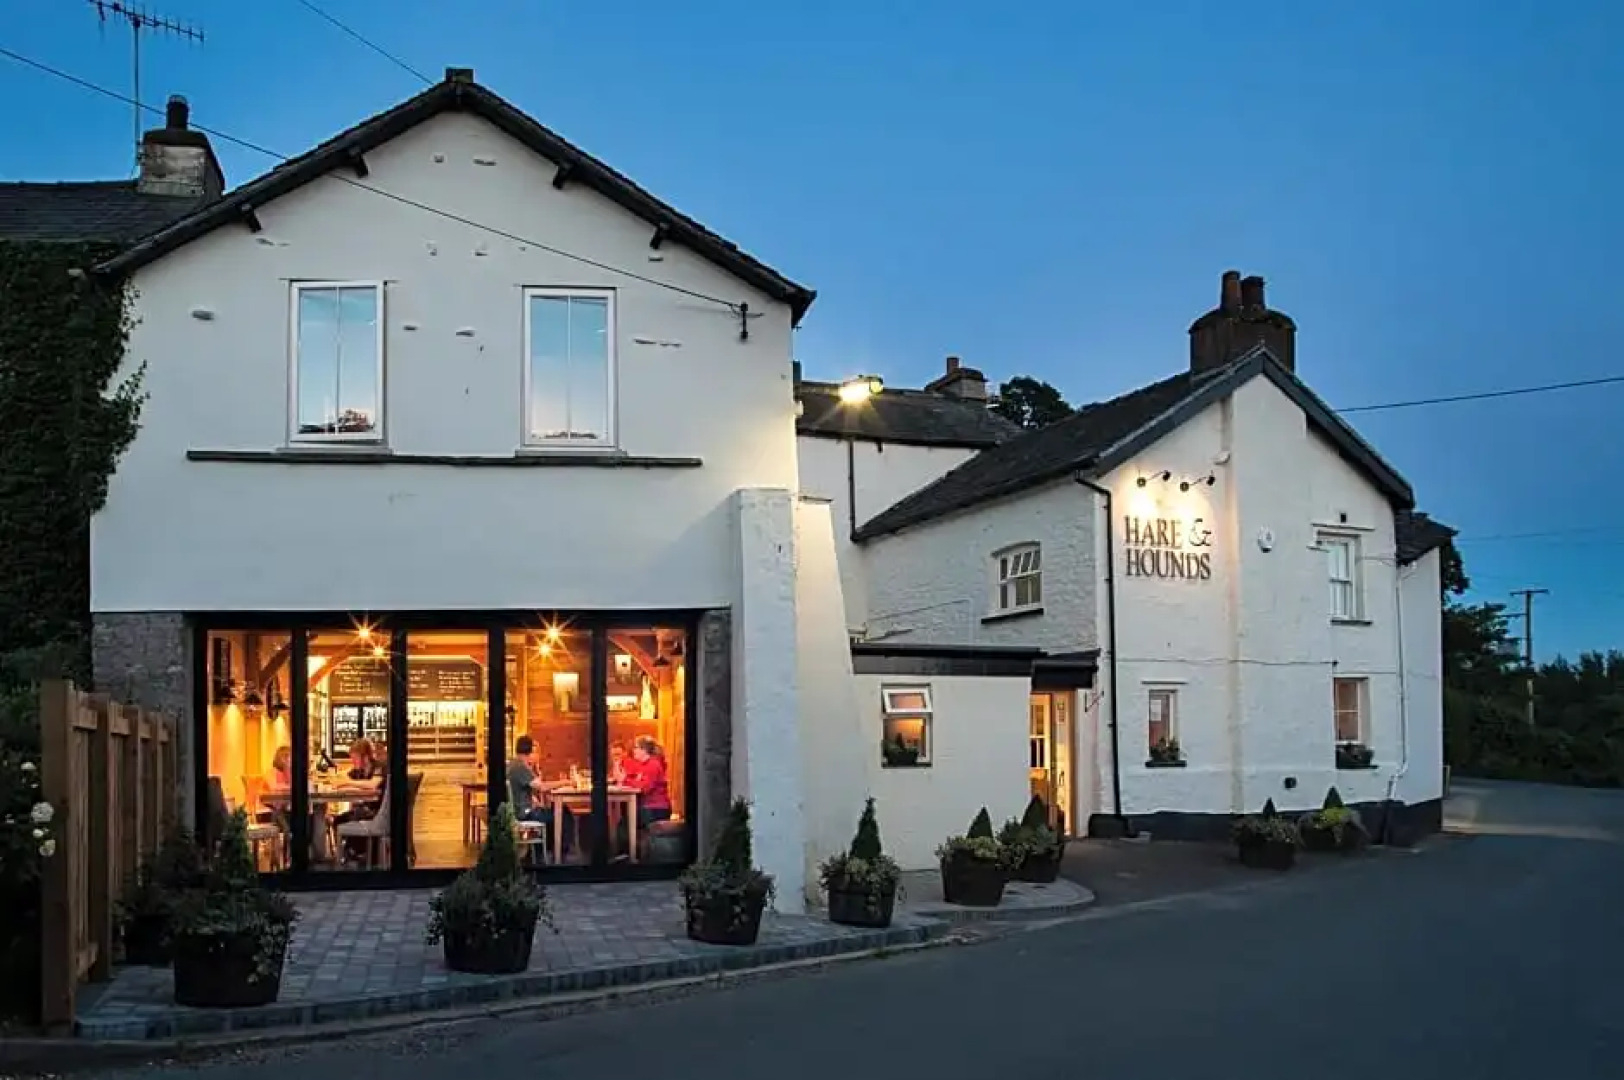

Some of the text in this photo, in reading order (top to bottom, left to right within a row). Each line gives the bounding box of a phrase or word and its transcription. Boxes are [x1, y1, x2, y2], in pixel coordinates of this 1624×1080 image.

[1124, 515, 1211, 549] HARE &
[1126, 548, 1211, 580] HOUNDS
